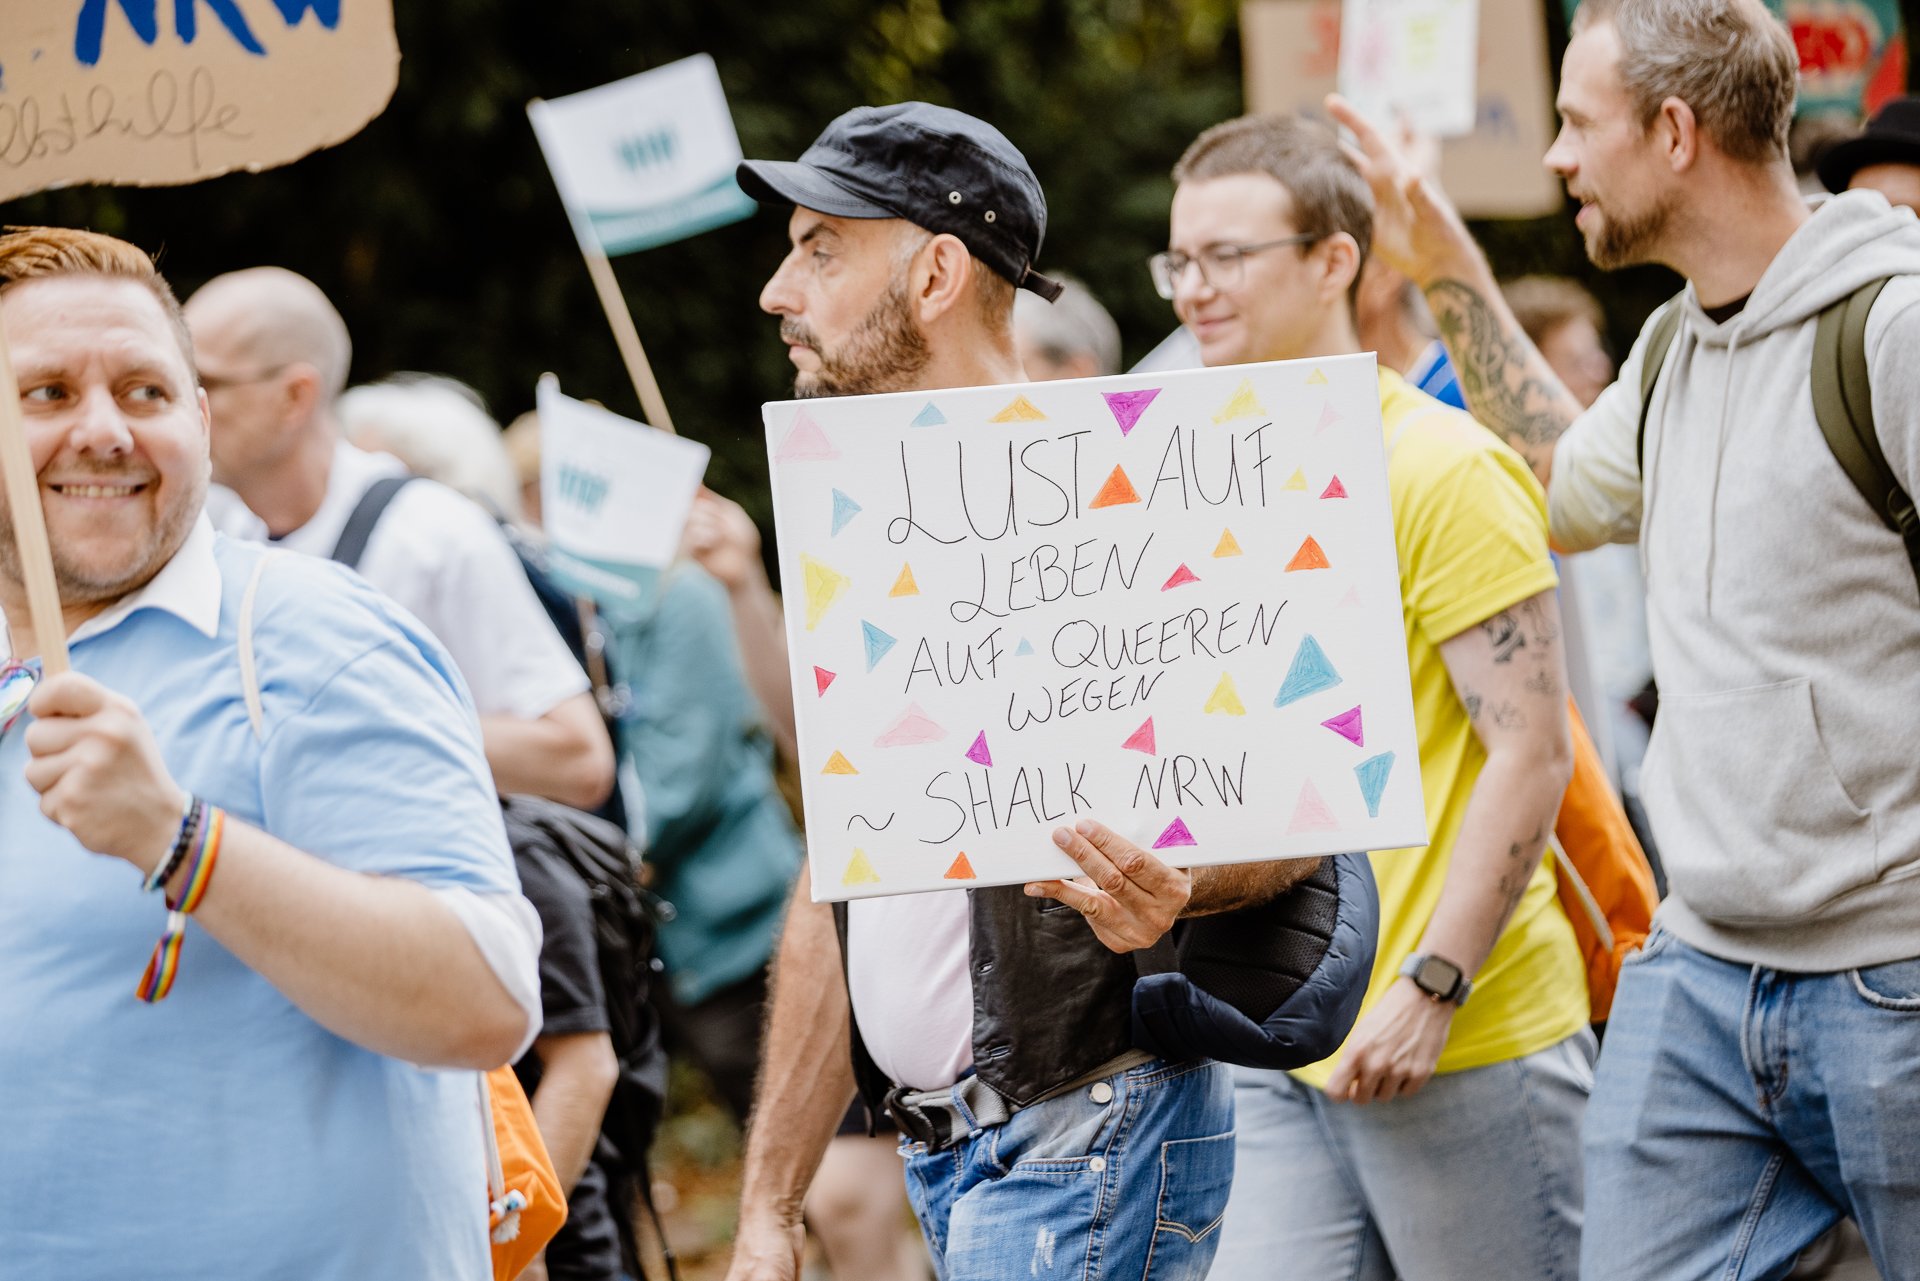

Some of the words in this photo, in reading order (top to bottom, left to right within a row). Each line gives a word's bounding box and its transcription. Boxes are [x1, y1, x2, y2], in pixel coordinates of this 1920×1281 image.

[887, 430, 1092, 545] LUST
[1146, 422, 1273, 509] AUF
[949, 532, 1154, 623] LEBEN
[904, 627, 1004, 694] AUF
[1052, 600, 1288, 671] QUEEREN
[1007, 671, 1165, 732] WEGEN
[919, 762, 1092, 845] SHALK
[1132, 752, 1247, 809] NRW
